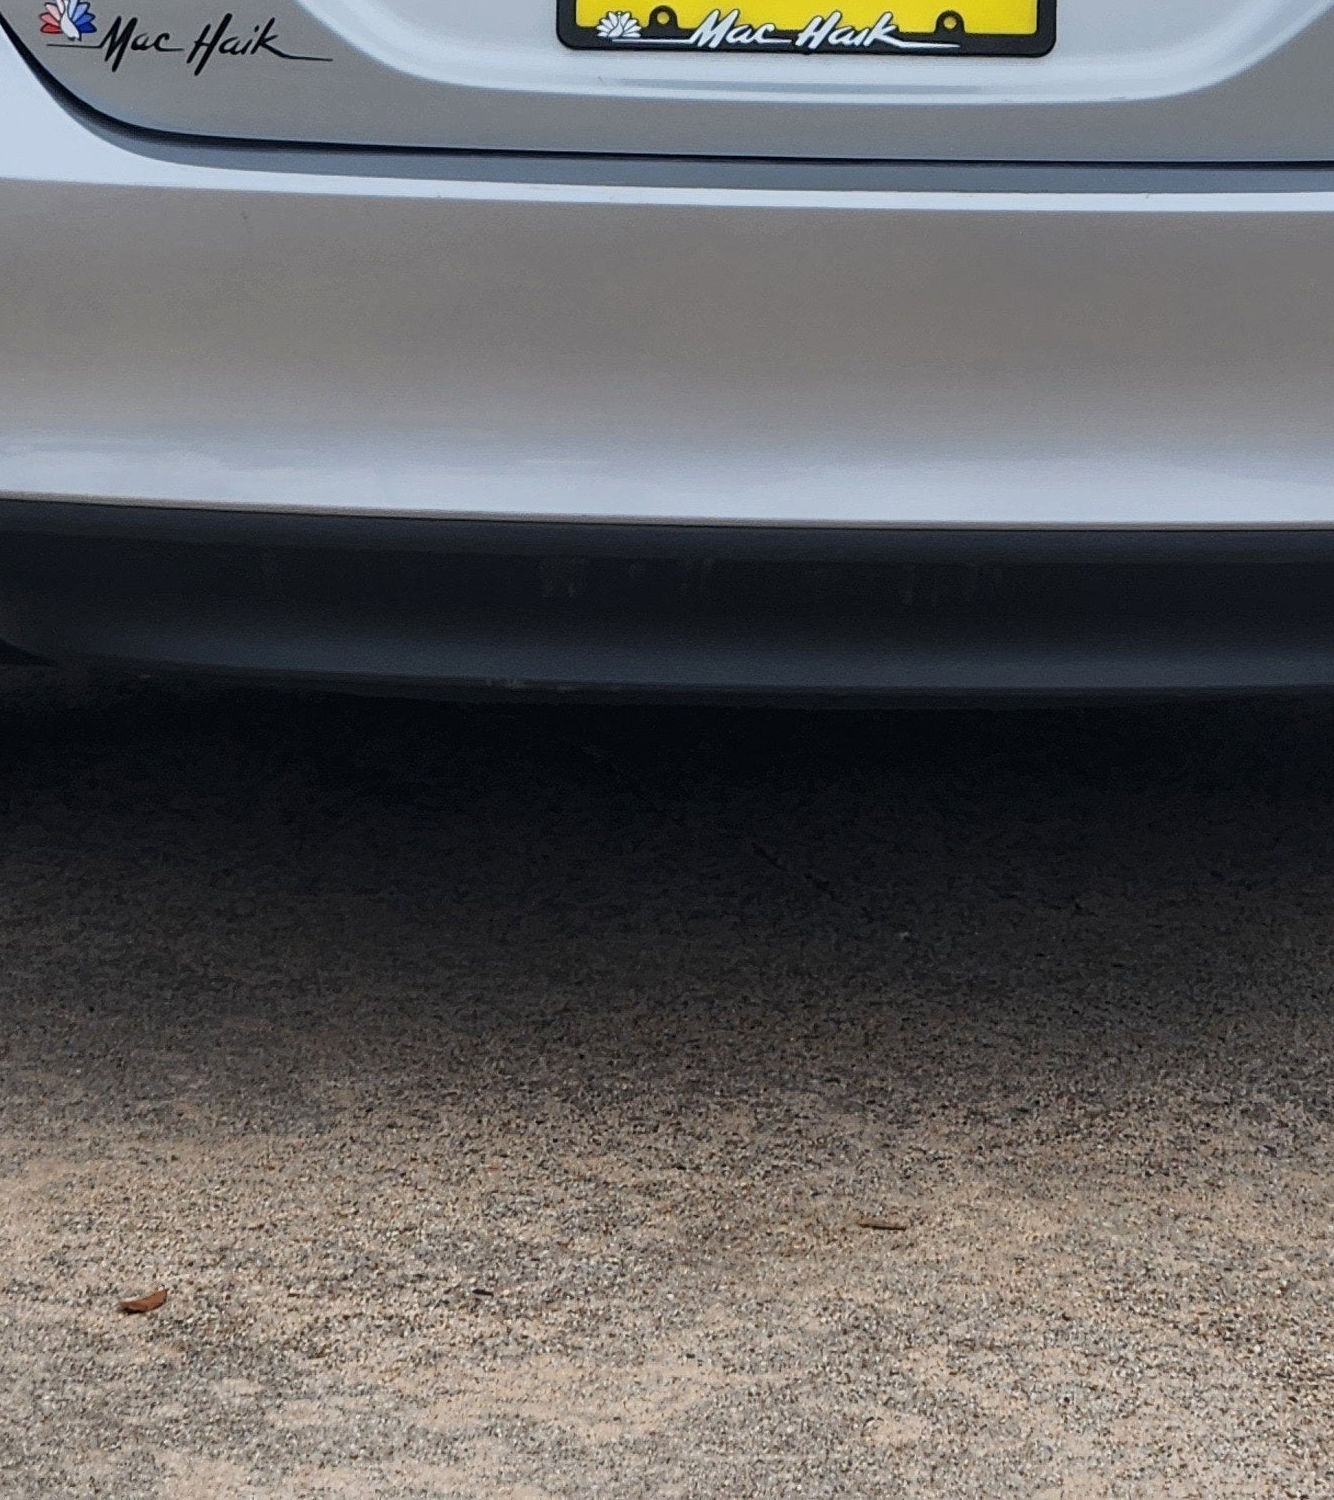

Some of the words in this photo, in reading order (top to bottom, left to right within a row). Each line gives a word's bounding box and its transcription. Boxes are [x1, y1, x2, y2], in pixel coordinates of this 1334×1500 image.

[103, 15, 184, 72] Mac
[186, 13, 333, 76] Haik
[687, 8, 792, 48] Mac
[794, 10, 960, 49] Haik
